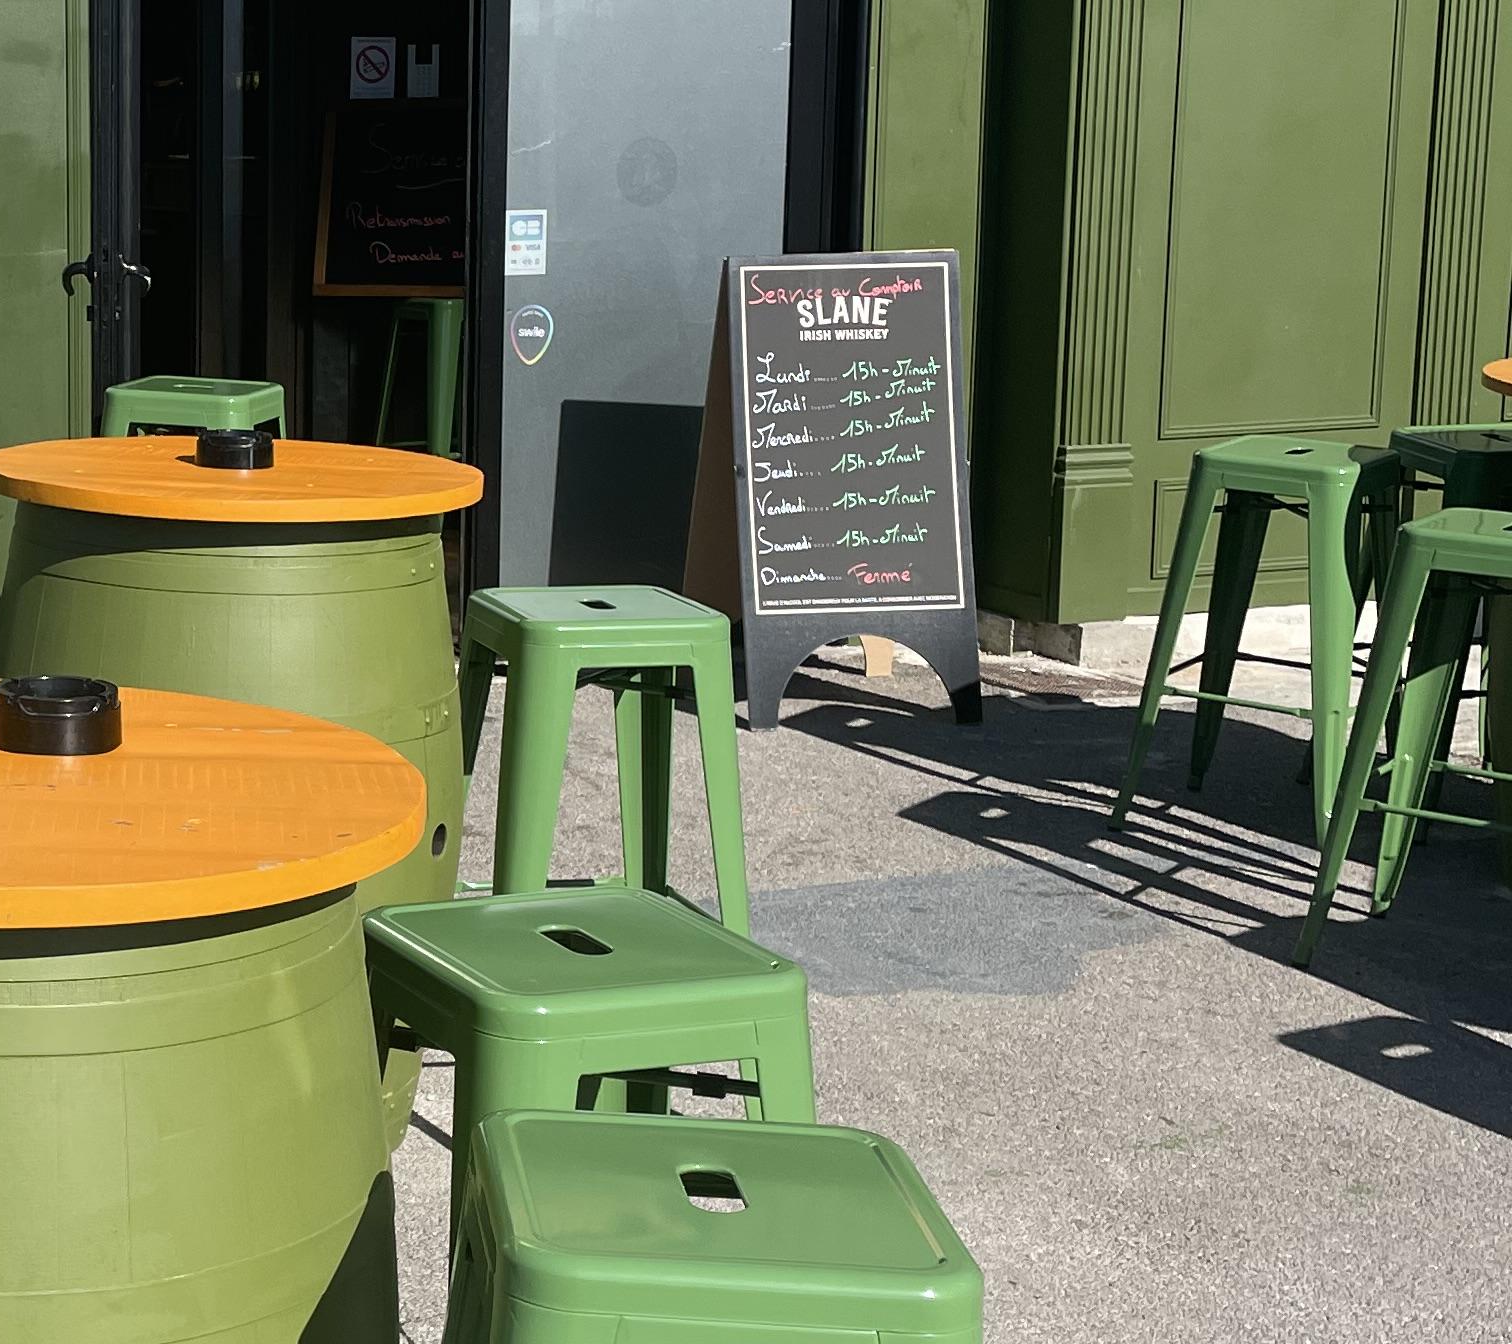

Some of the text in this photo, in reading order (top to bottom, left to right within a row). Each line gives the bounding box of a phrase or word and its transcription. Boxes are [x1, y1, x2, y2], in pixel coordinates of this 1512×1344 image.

[748, 273, 923, 305] Service au Comptoir
[796, 295, 893, 328] SLANE
[799, 328, 890, 341] IRISH WHISKEY
[847, 561, 913, 586] Fermé
